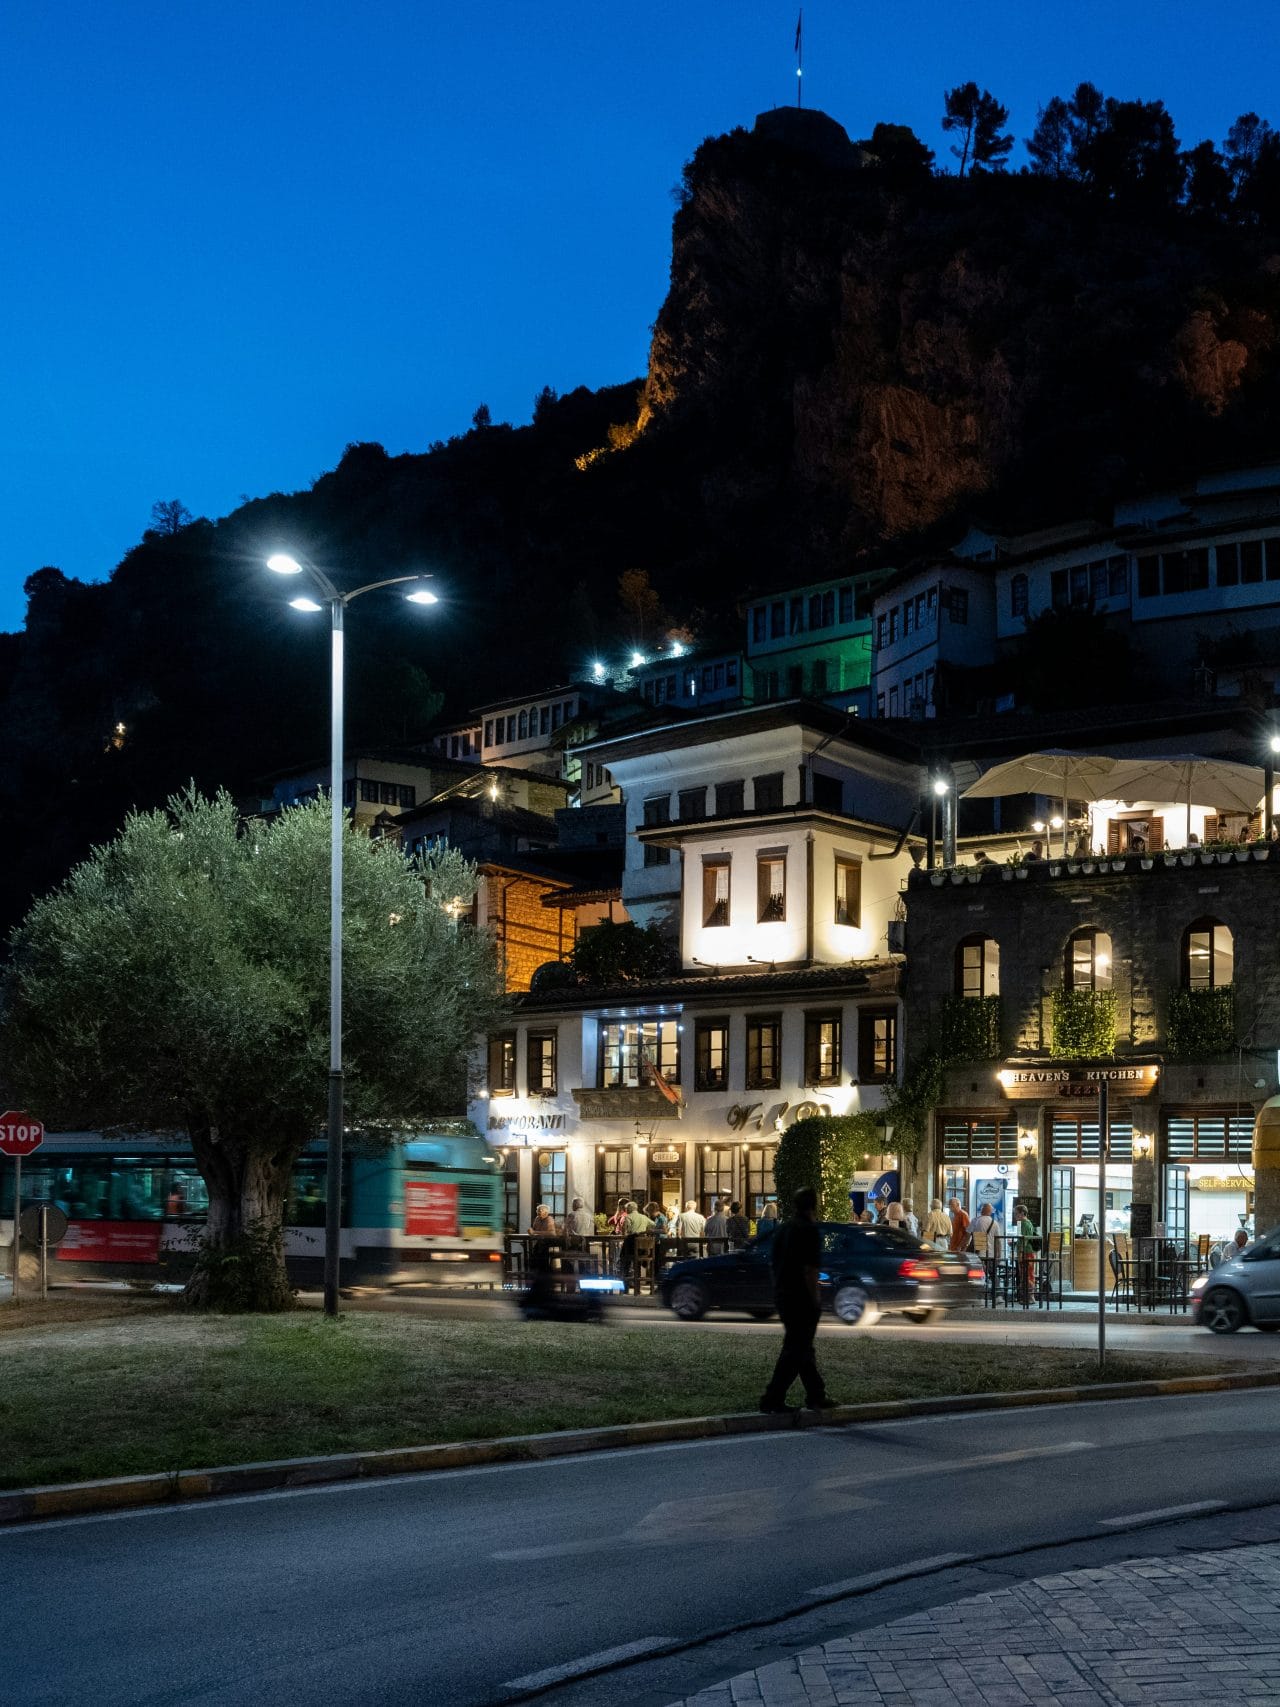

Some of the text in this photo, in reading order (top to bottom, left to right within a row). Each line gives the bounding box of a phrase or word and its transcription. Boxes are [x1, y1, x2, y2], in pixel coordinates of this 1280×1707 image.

[1012, 1070, 1144, 1082] HEAVEN'S KITCHEN
[0, 1125, 40, 1142] STOP
